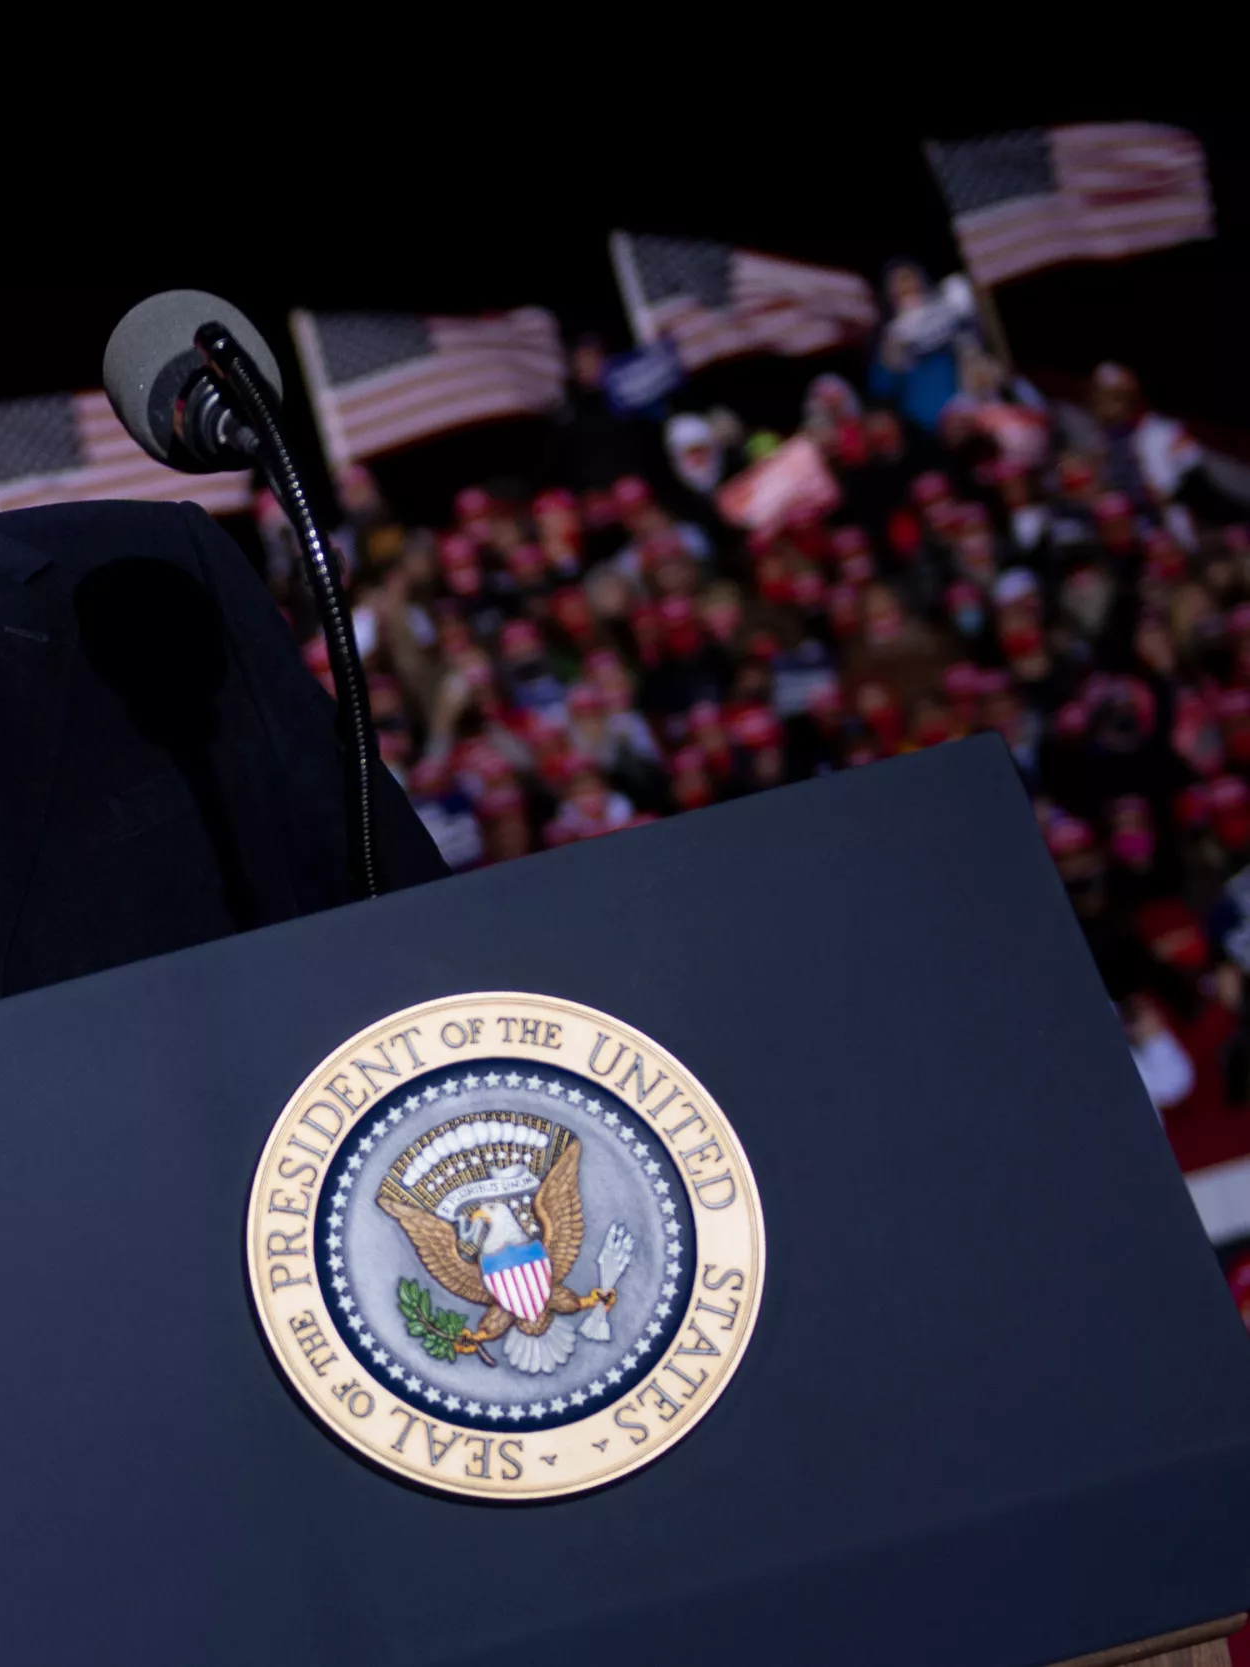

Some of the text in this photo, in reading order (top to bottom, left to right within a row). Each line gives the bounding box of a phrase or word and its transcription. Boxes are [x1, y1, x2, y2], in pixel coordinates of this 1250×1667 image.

[266, 1017, 745, 1480] SEAL OF THE PRESIDENT OF THE UNITED STATES
